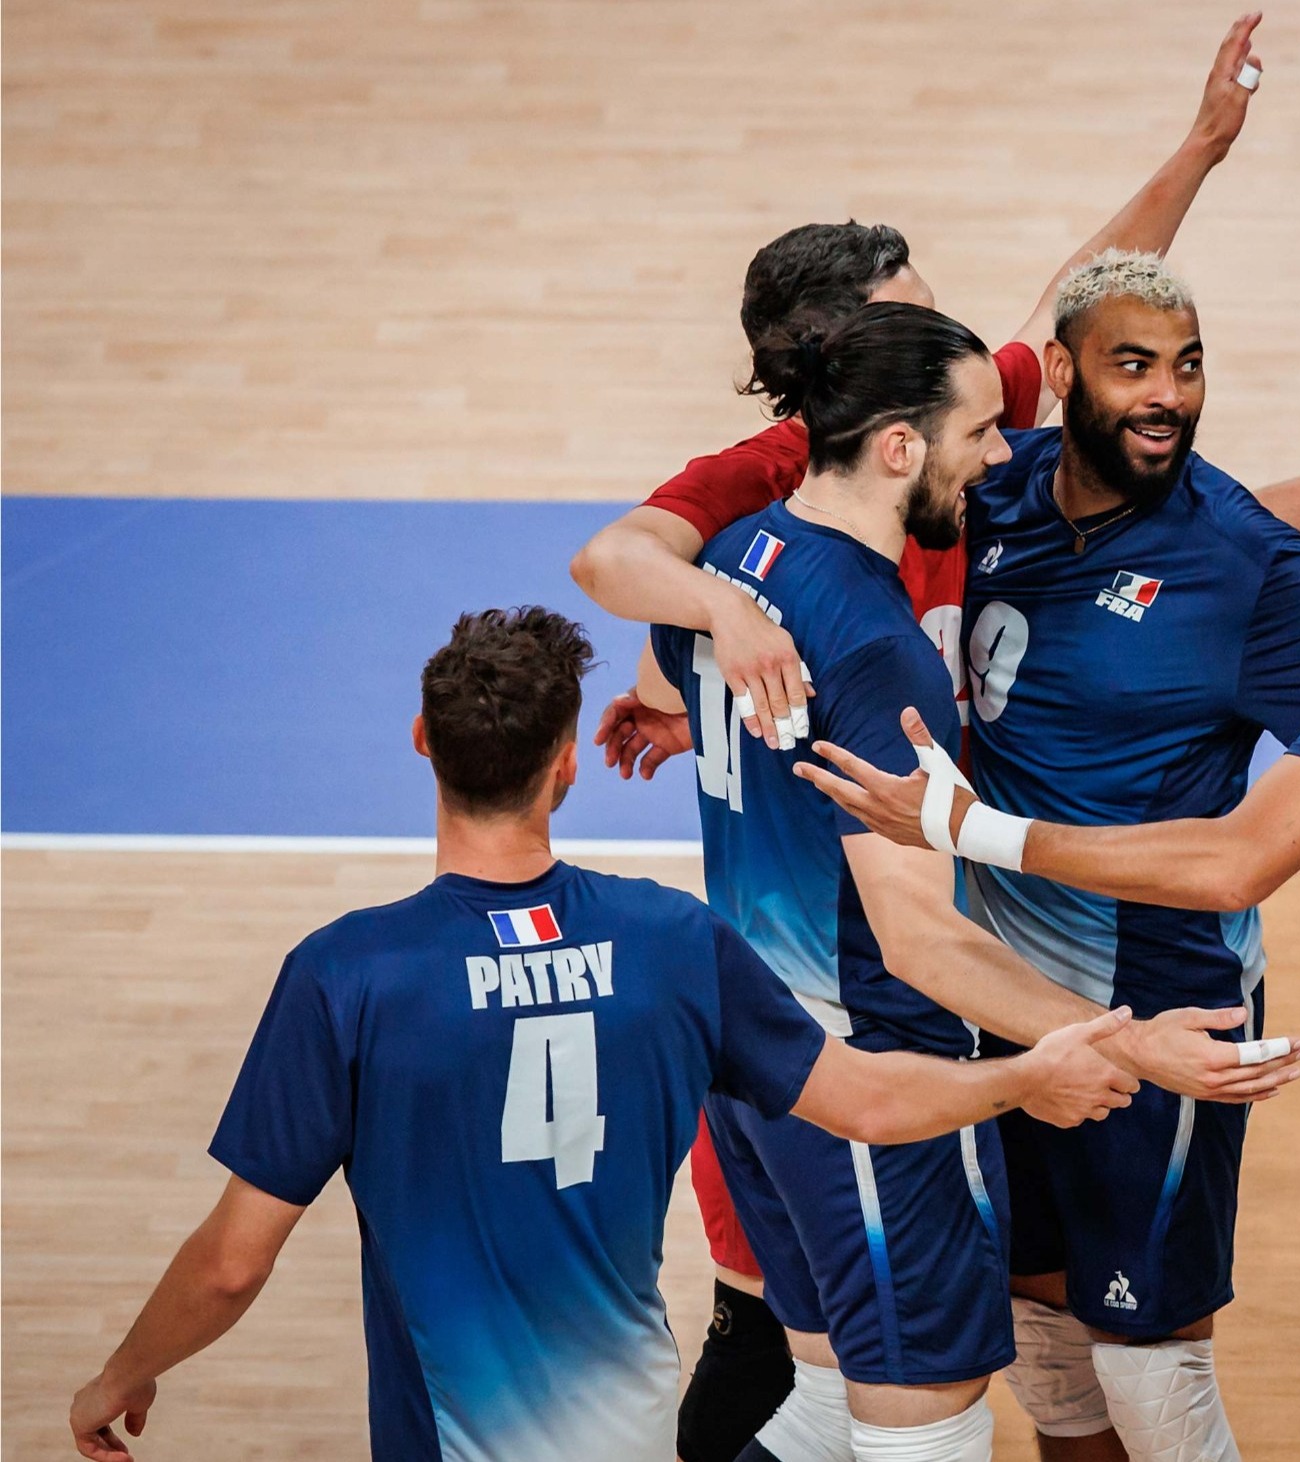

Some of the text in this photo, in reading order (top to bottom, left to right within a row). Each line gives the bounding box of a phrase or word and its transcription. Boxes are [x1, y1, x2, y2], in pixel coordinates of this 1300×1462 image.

[1094, 590, 1146, 623] FRA
[967, 600, 1029, 723] 9
[465, 940, 614, 1010] PATRY
[500, 1011, 606, 1191] 4
